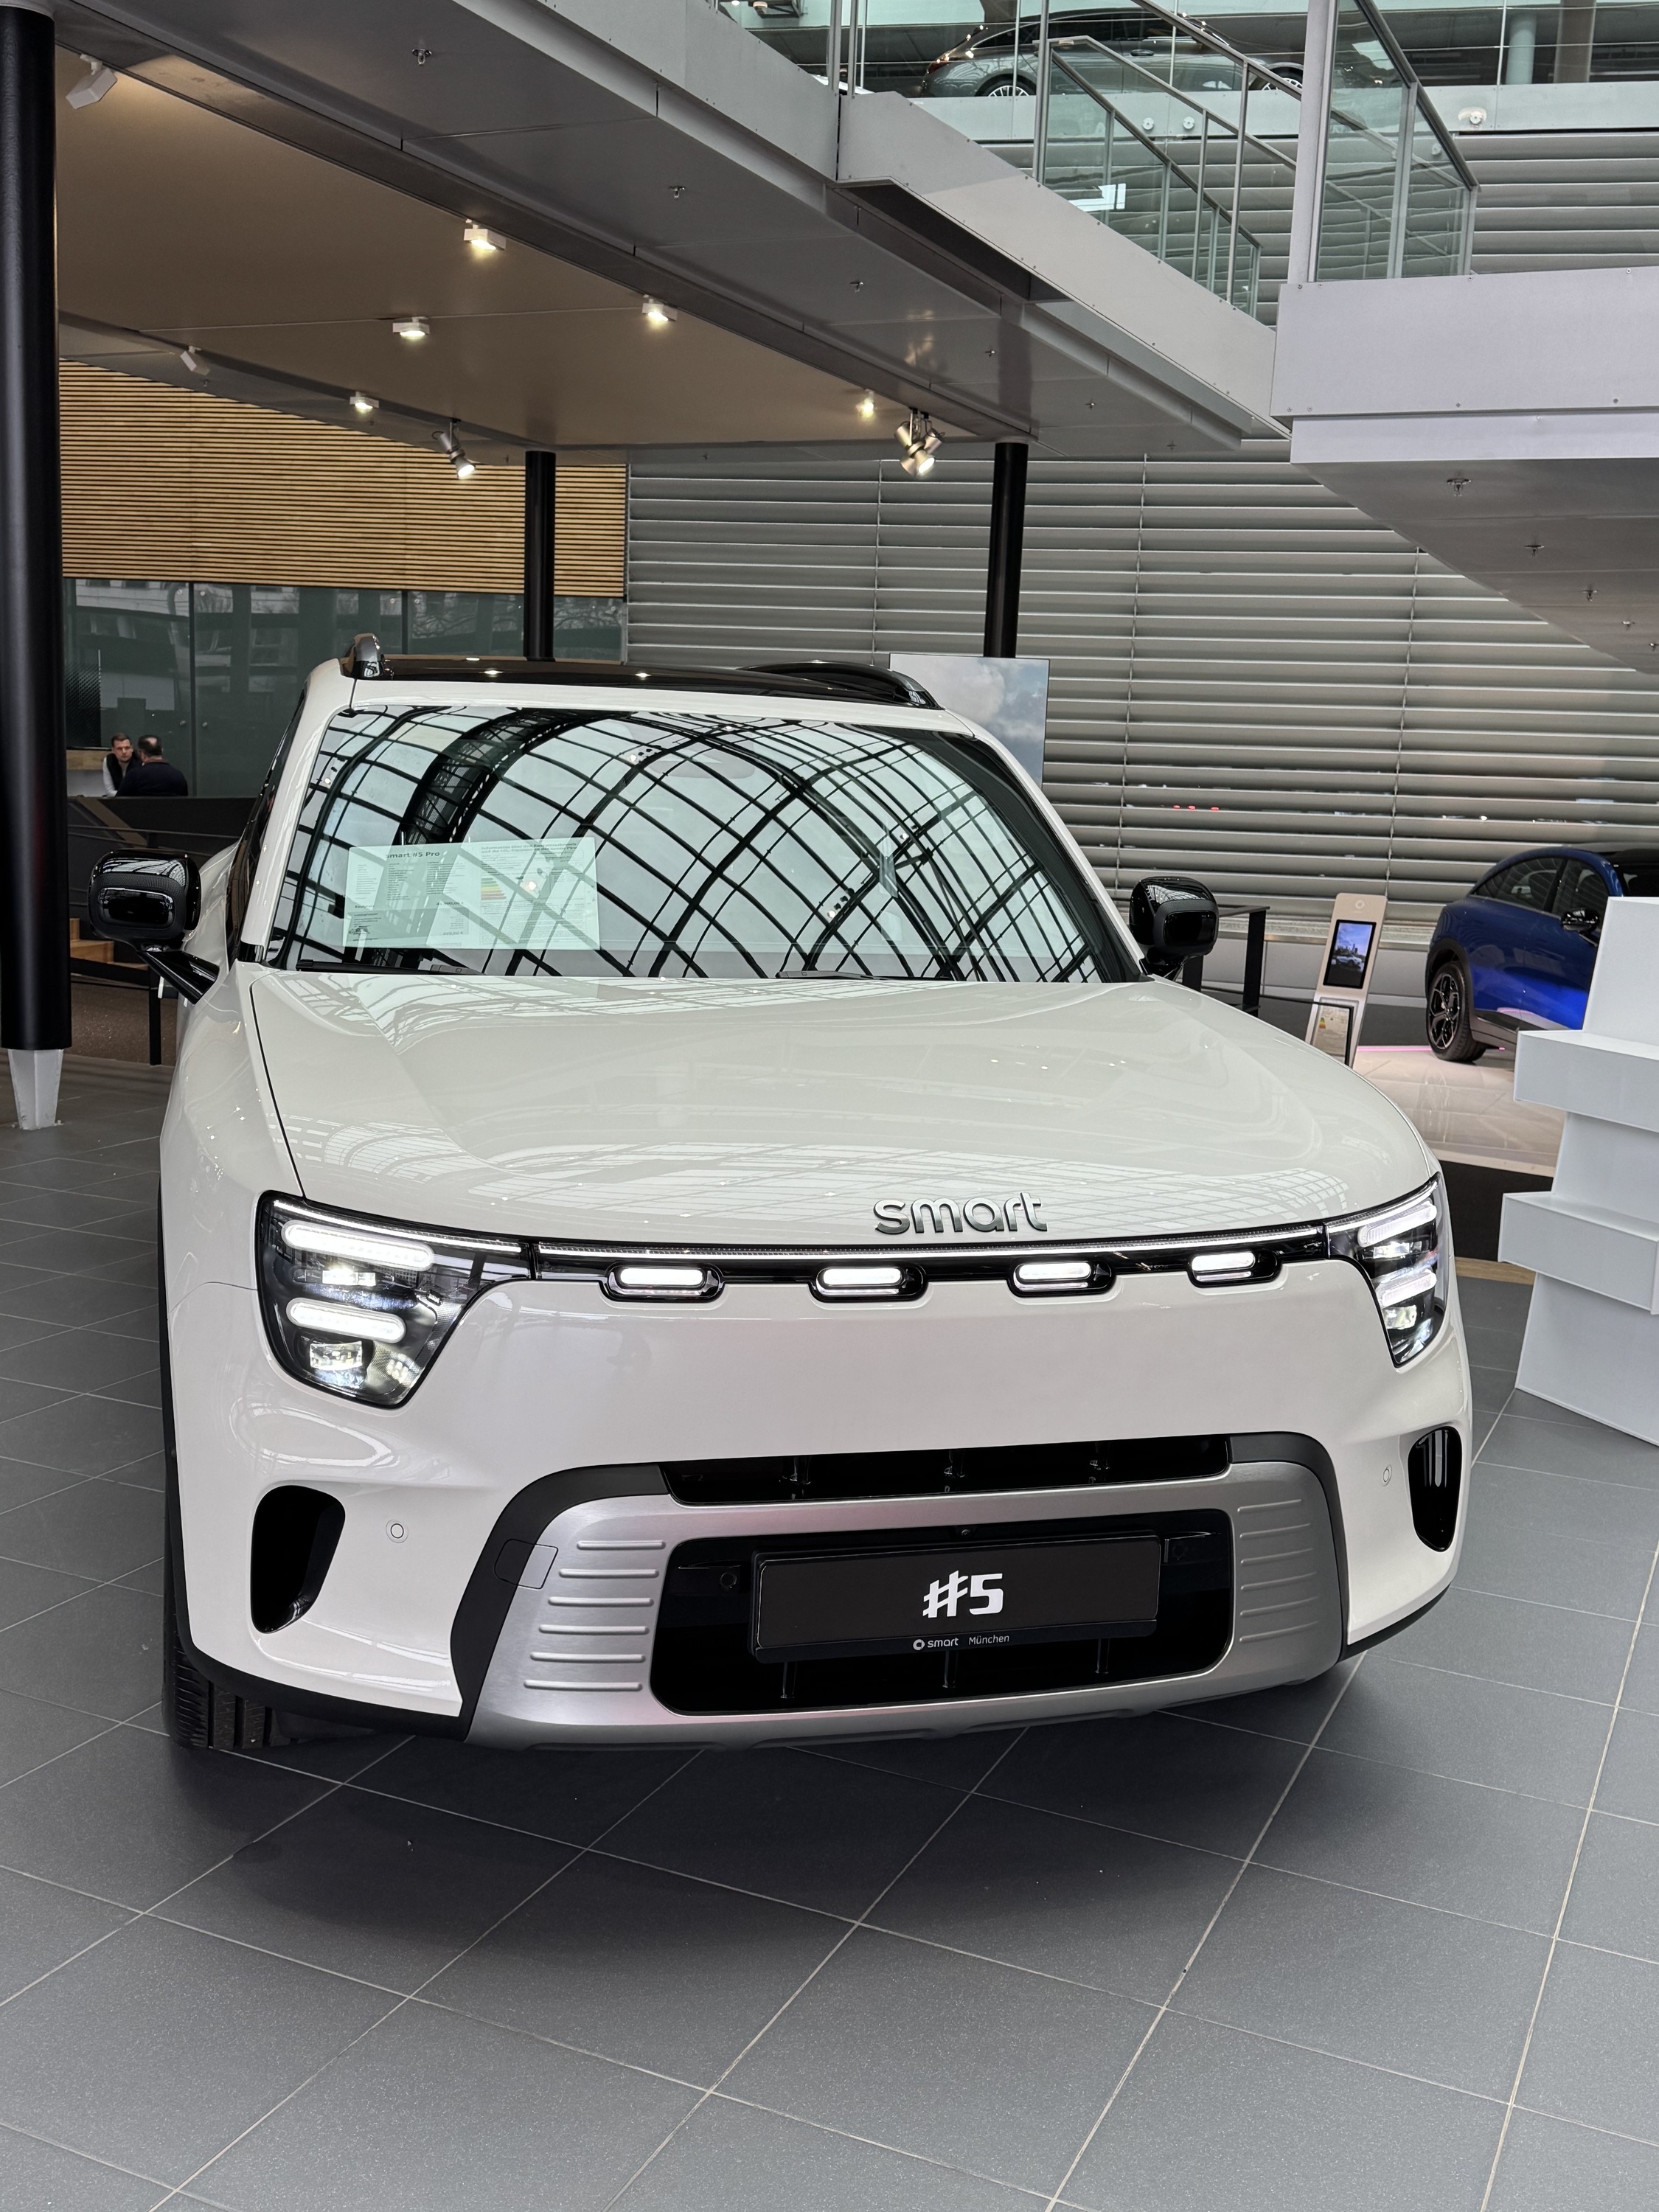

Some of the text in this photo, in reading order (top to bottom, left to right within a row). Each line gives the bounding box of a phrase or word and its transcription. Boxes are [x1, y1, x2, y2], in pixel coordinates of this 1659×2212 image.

[873, 1192, 1048, 1235] smart
[922, 1570, 1004, 1618] #5
[927, 1635, 1010, 1648] smart München
